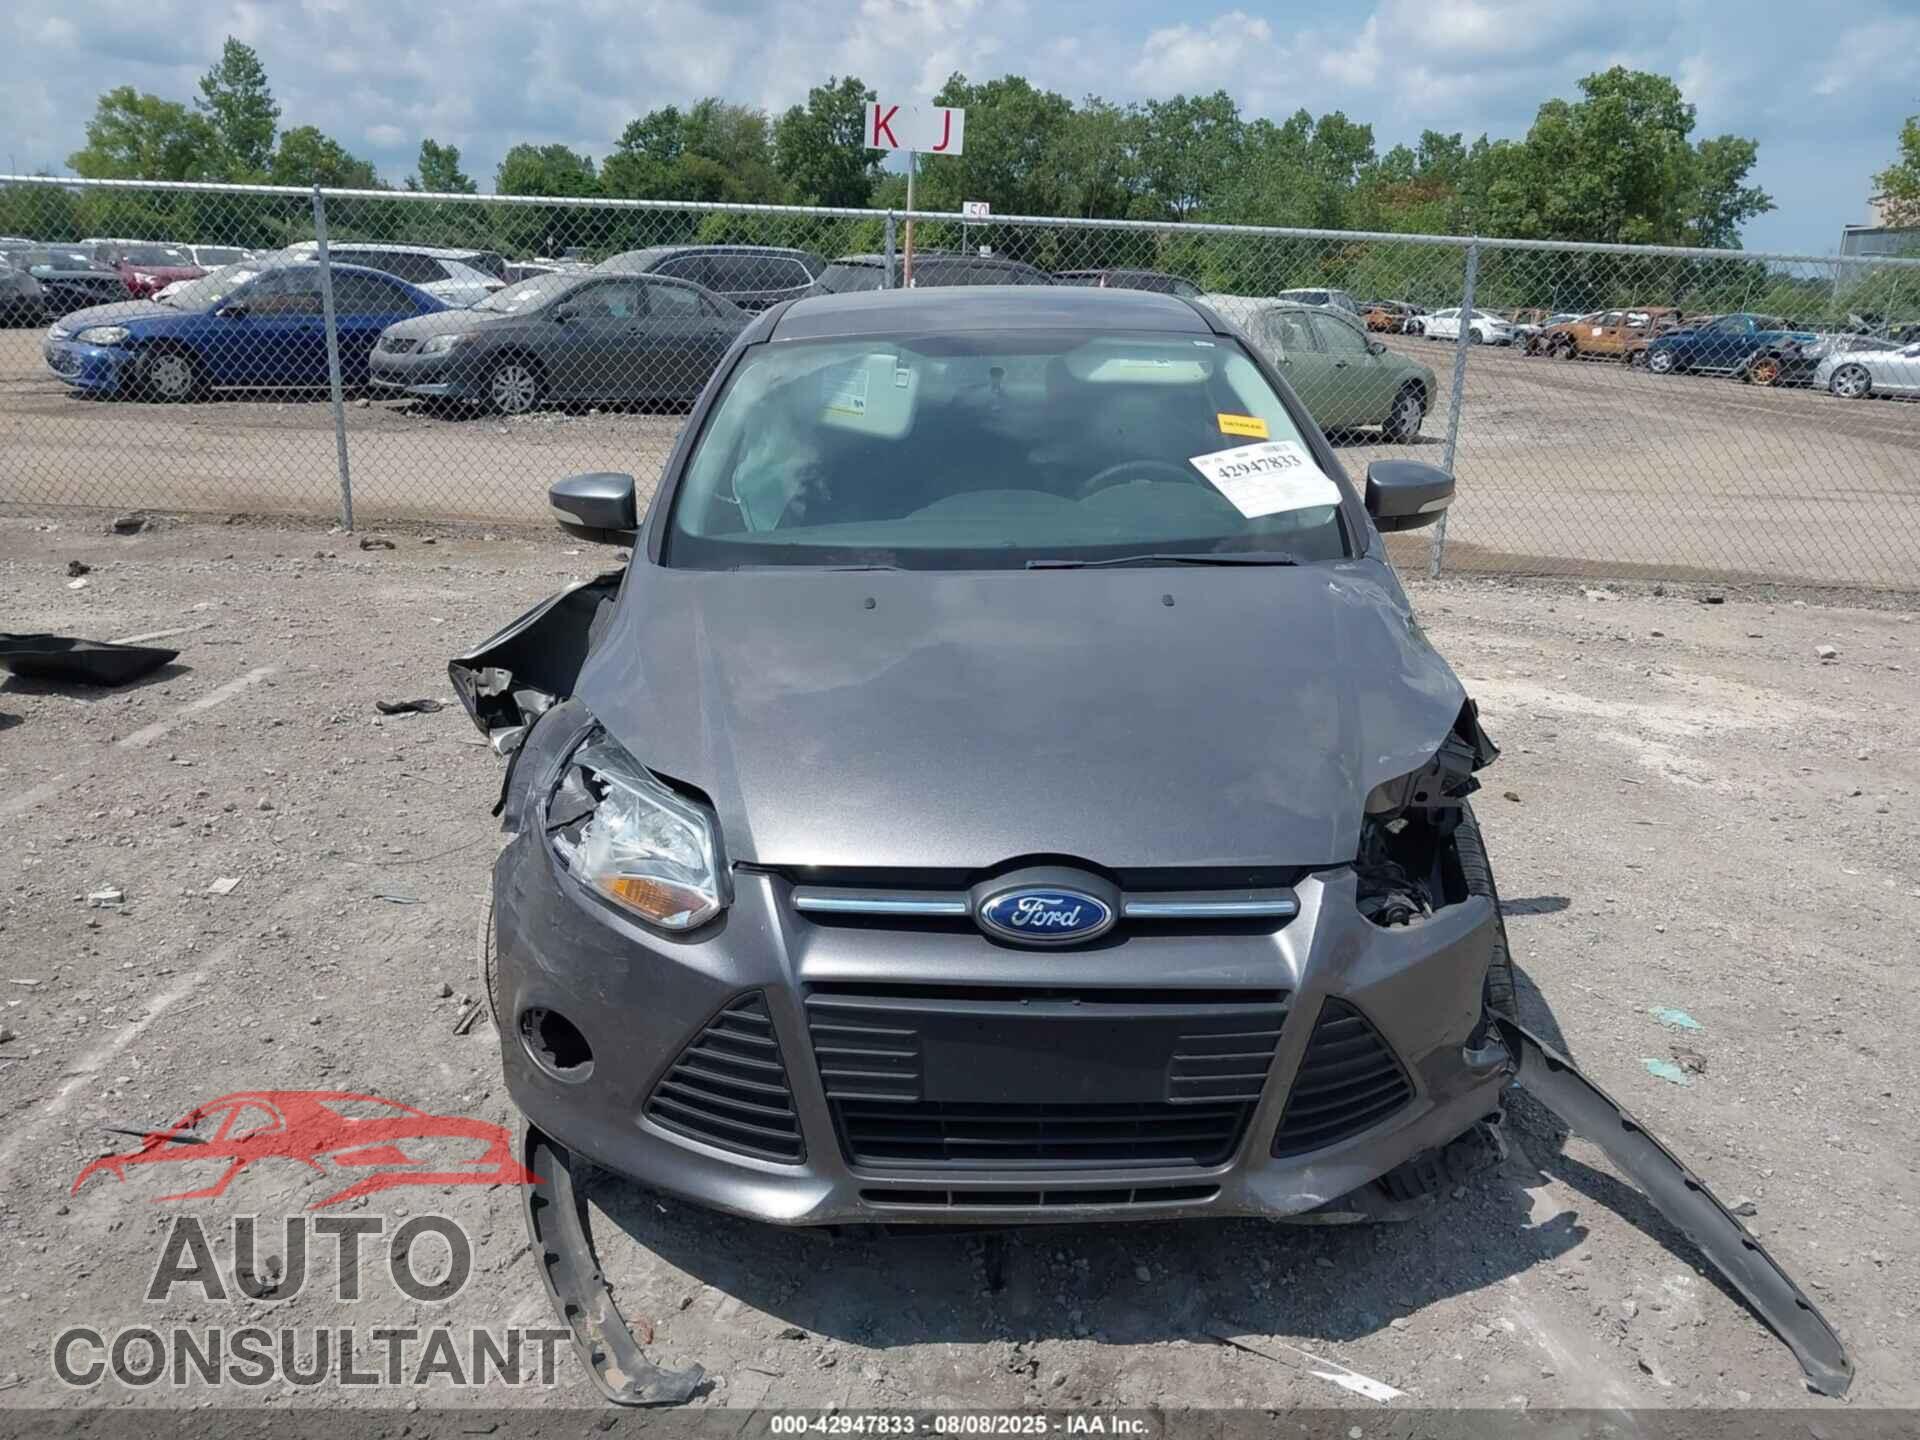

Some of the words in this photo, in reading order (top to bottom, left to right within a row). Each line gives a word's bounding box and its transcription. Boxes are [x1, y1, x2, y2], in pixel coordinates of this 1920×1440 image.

[873, 104, 899, 148] K
[933, 110, 951, 151] J
[1217, 454, 1302, 480] 42947833
[1011, 897, 1082, 927] Ford
